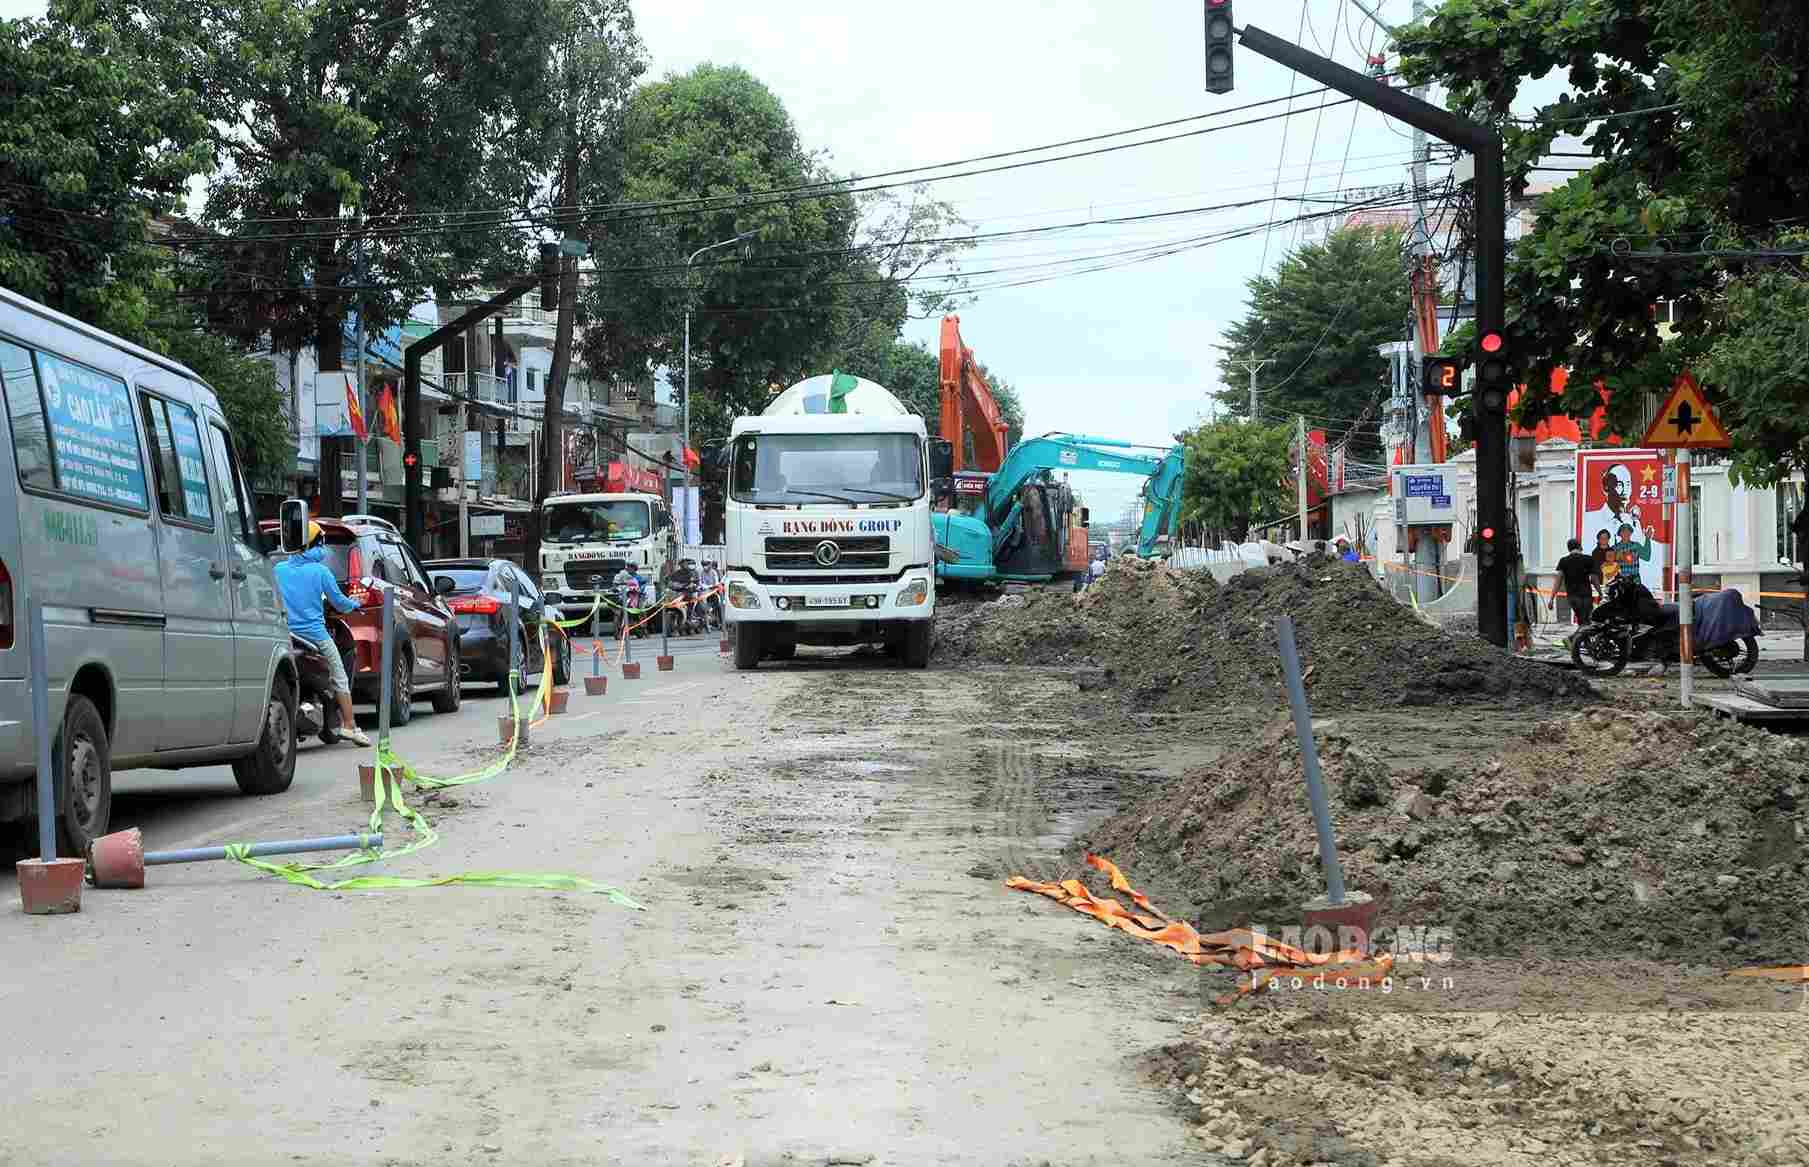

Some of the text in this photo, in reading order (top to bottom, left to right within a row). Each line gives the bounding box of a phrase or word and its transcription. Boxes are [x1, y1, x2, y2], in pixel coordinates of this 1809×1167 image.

[1442, 366, 1455, 387] 2
[1639, 484, 1658, 498] 2-9
[859, 519, 901, 531] GROUP
